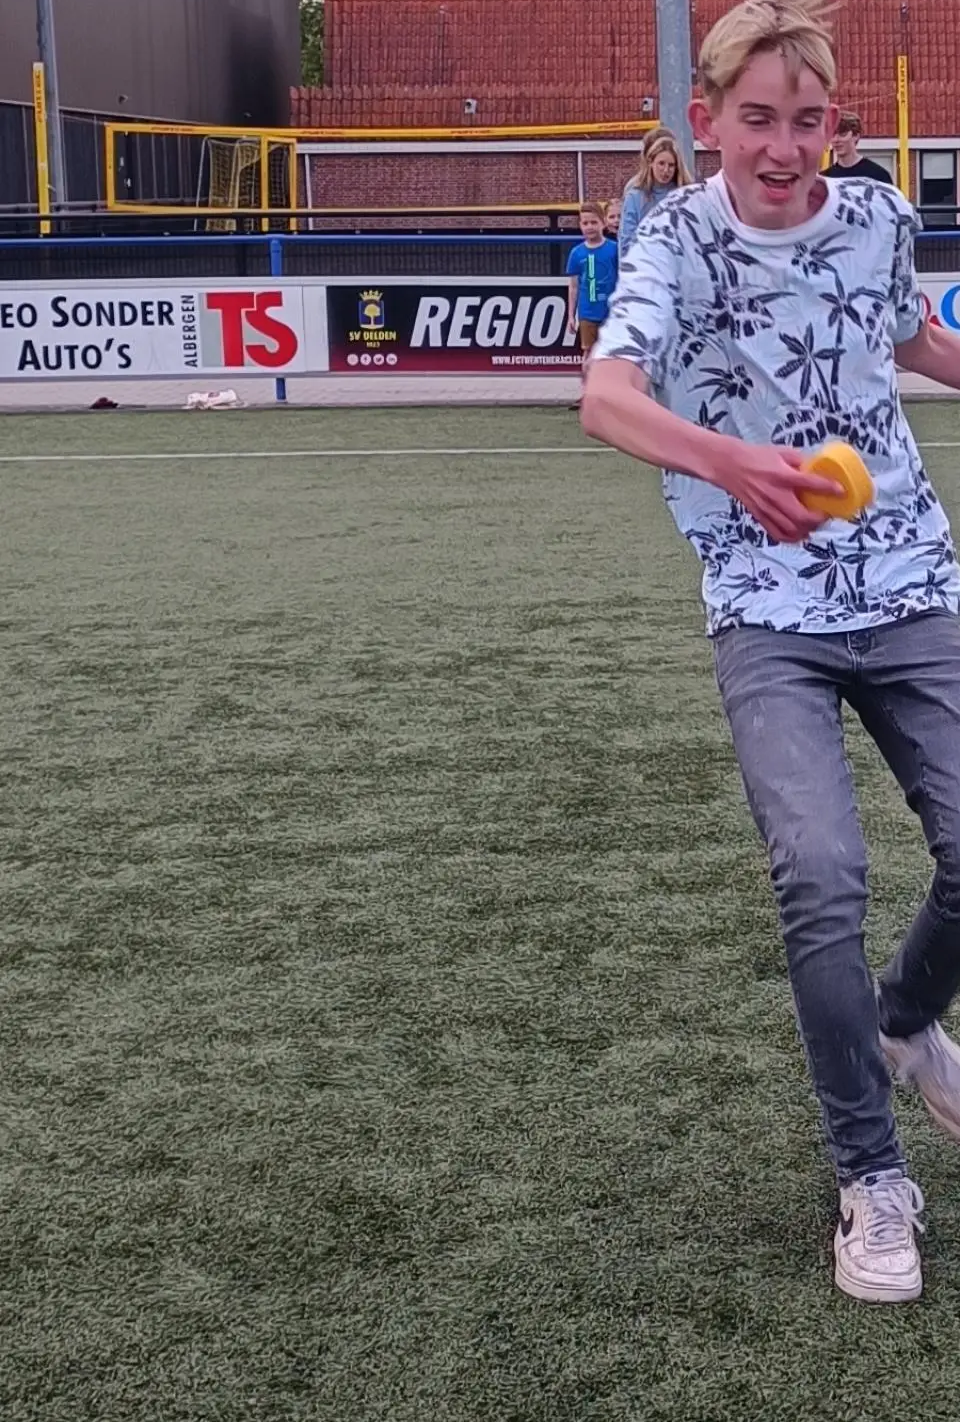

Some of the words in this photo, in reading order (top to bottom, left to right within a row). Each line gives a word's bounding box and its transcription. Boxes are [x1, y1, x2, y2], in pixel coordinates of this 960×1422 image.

[0, 303, 38, 328] EO
[50, 295, 175, 328] SONDER
[180, 294, 198, 368] ALBERGEN
[206, 291, 299, 368] TS
[17, 338, 132, 371] AUTO'S
